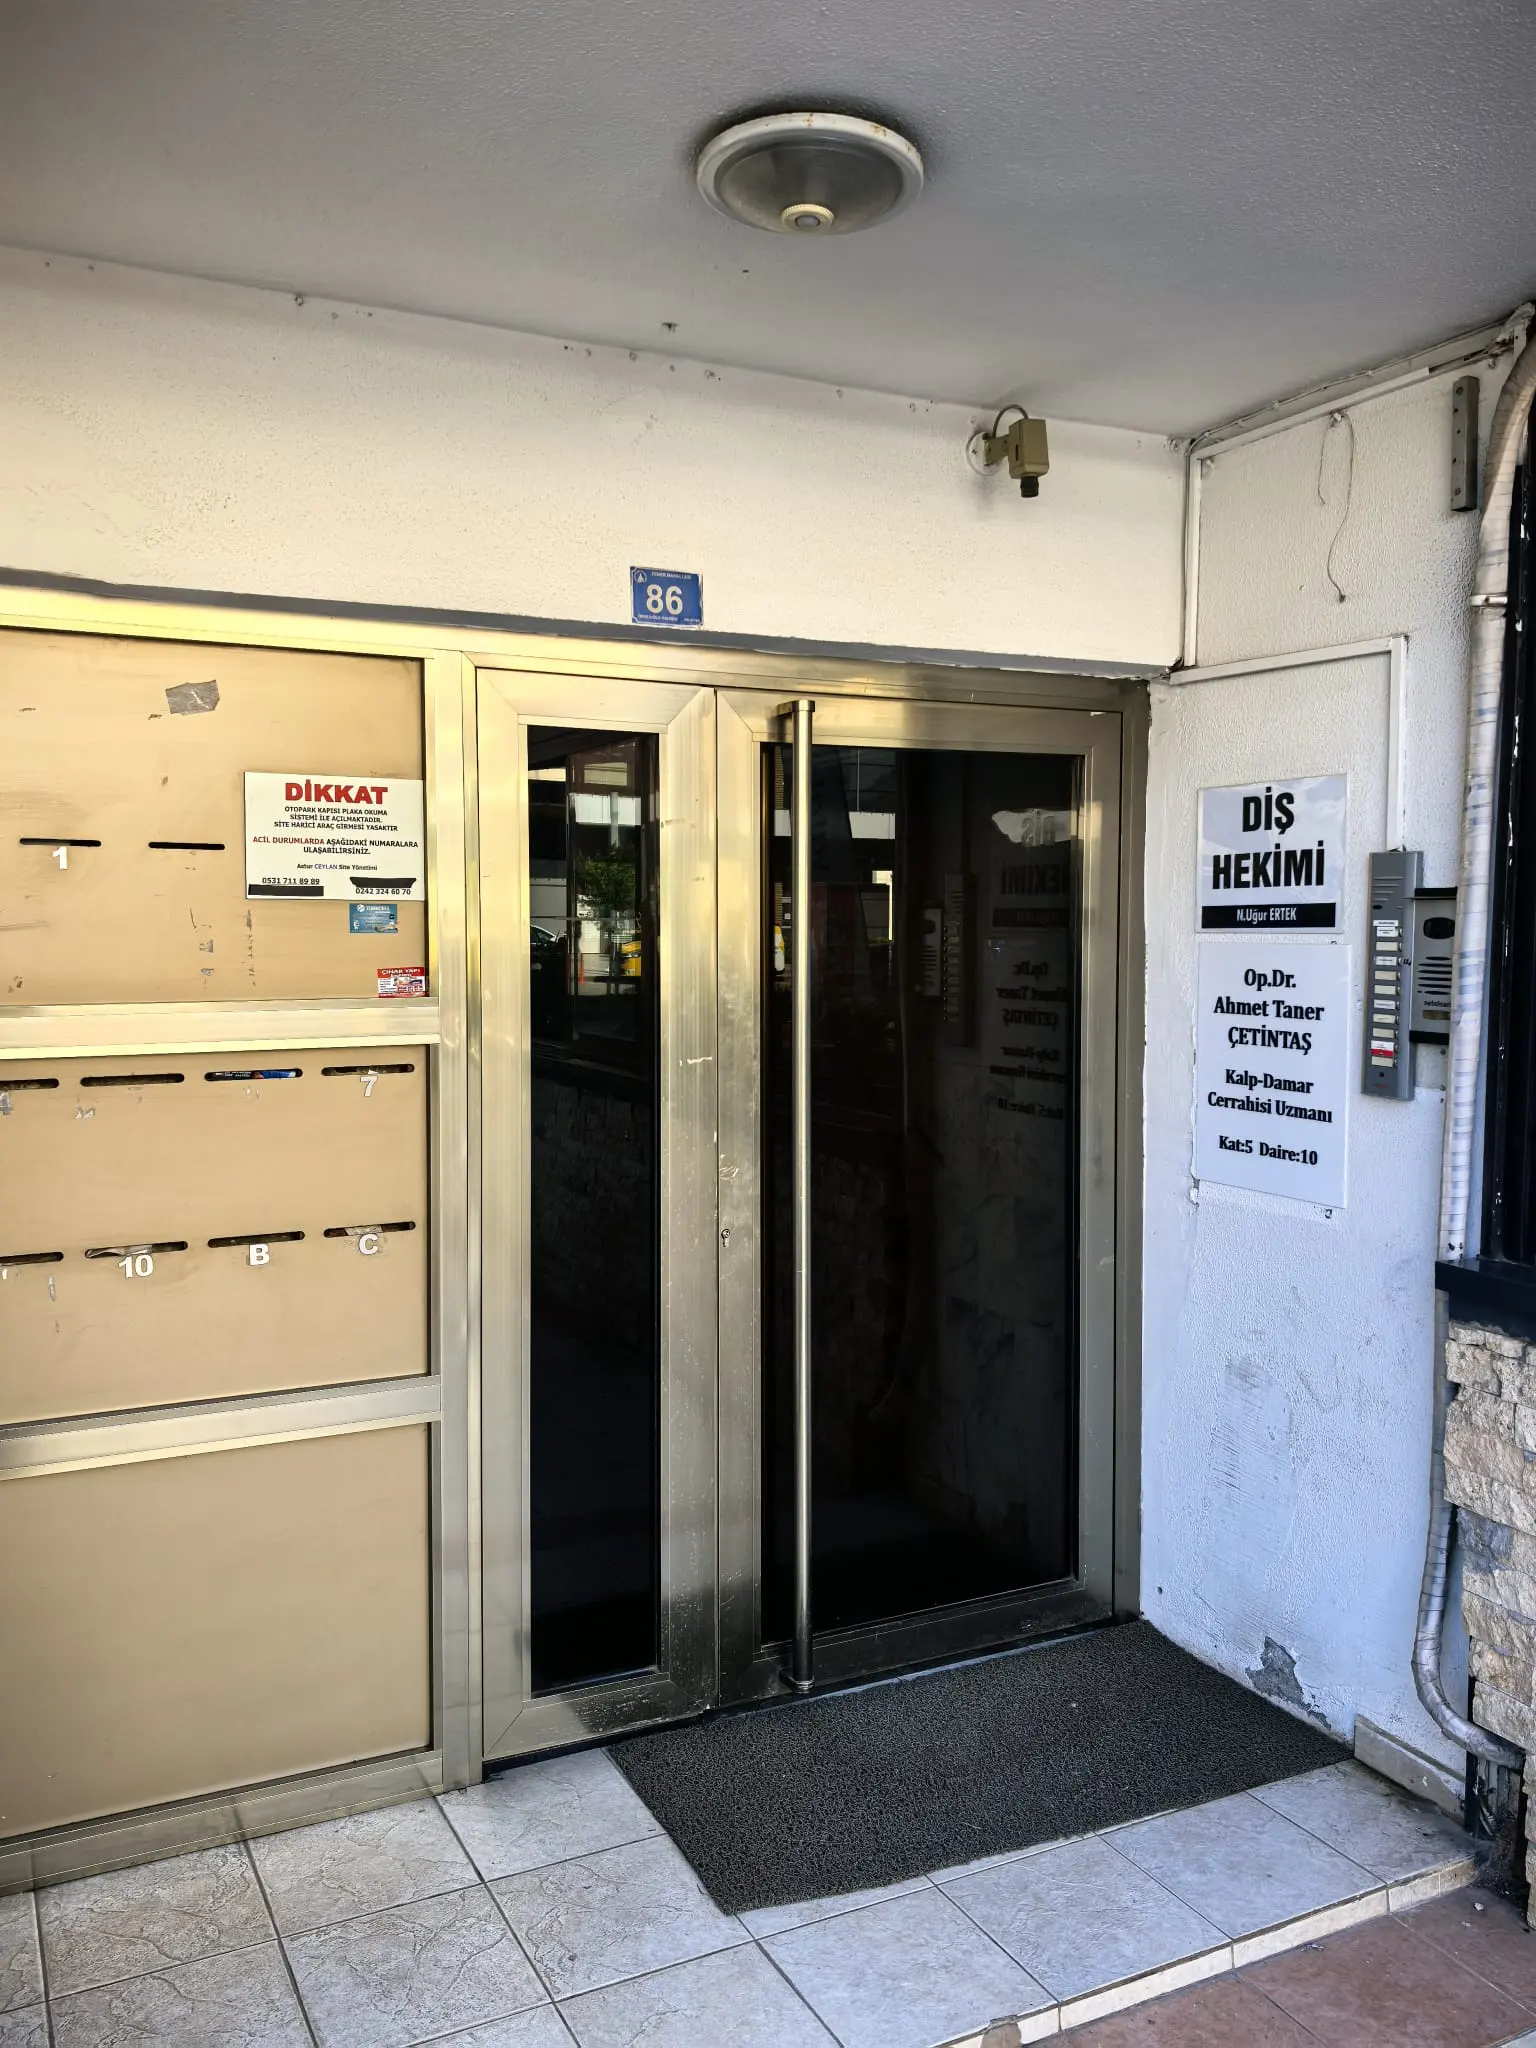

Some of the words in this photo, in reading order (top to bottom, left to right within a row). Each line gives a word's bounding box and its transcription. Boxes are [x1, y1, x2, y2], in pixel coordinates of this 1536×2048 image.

[646, 584, 683, 615] 86
[285, 779, 388, 805] DİKKAT
[290, 813, 318, 821] SİSTEMİ
[1242, 786, 1294, 835] DİŞ
[274, 820, 290, 828] SİTE
[336, 823, 364, 831] GİRMESİ
[272, 837, 325, 845] DURUMLARDA
[326, 837, 367, 847] AŞAĞIDAKİ
[369, 840, 419, 848] NUMARALARA
[52, 846, 68, 870] 1
[1212, 840, 1325, 890] HEKİMİ
[1236, 908, 1268, 924] N.Uğur
[1269, 907, 1297, 921] ERTEK
[1243, 968, 1297, 992] Op.Dr.
[1213, 996, 1269, 1017] Ahmet
[1272, 1000, 1325, 1021] Taner
[1228, 1025, 1312, 1055] ÇETİNTAŞ
[360, 1075, 378, 1097] 7
[1225, 1069, 1314, 1094] Kalp-Damar
[1208, 1092, 1272, 1115] Cerrahisi
[1275, 1100, 1333, 1123] Uzmanı
[1219, 1135, 1253, 1154] Kat:5
[1259, 1141, 1318, 1165] Daire:10
[249, 1244, 270, 1266] B
[358, 1233, 379, 1255] C
[118, 1254, 154, 1279] 10
